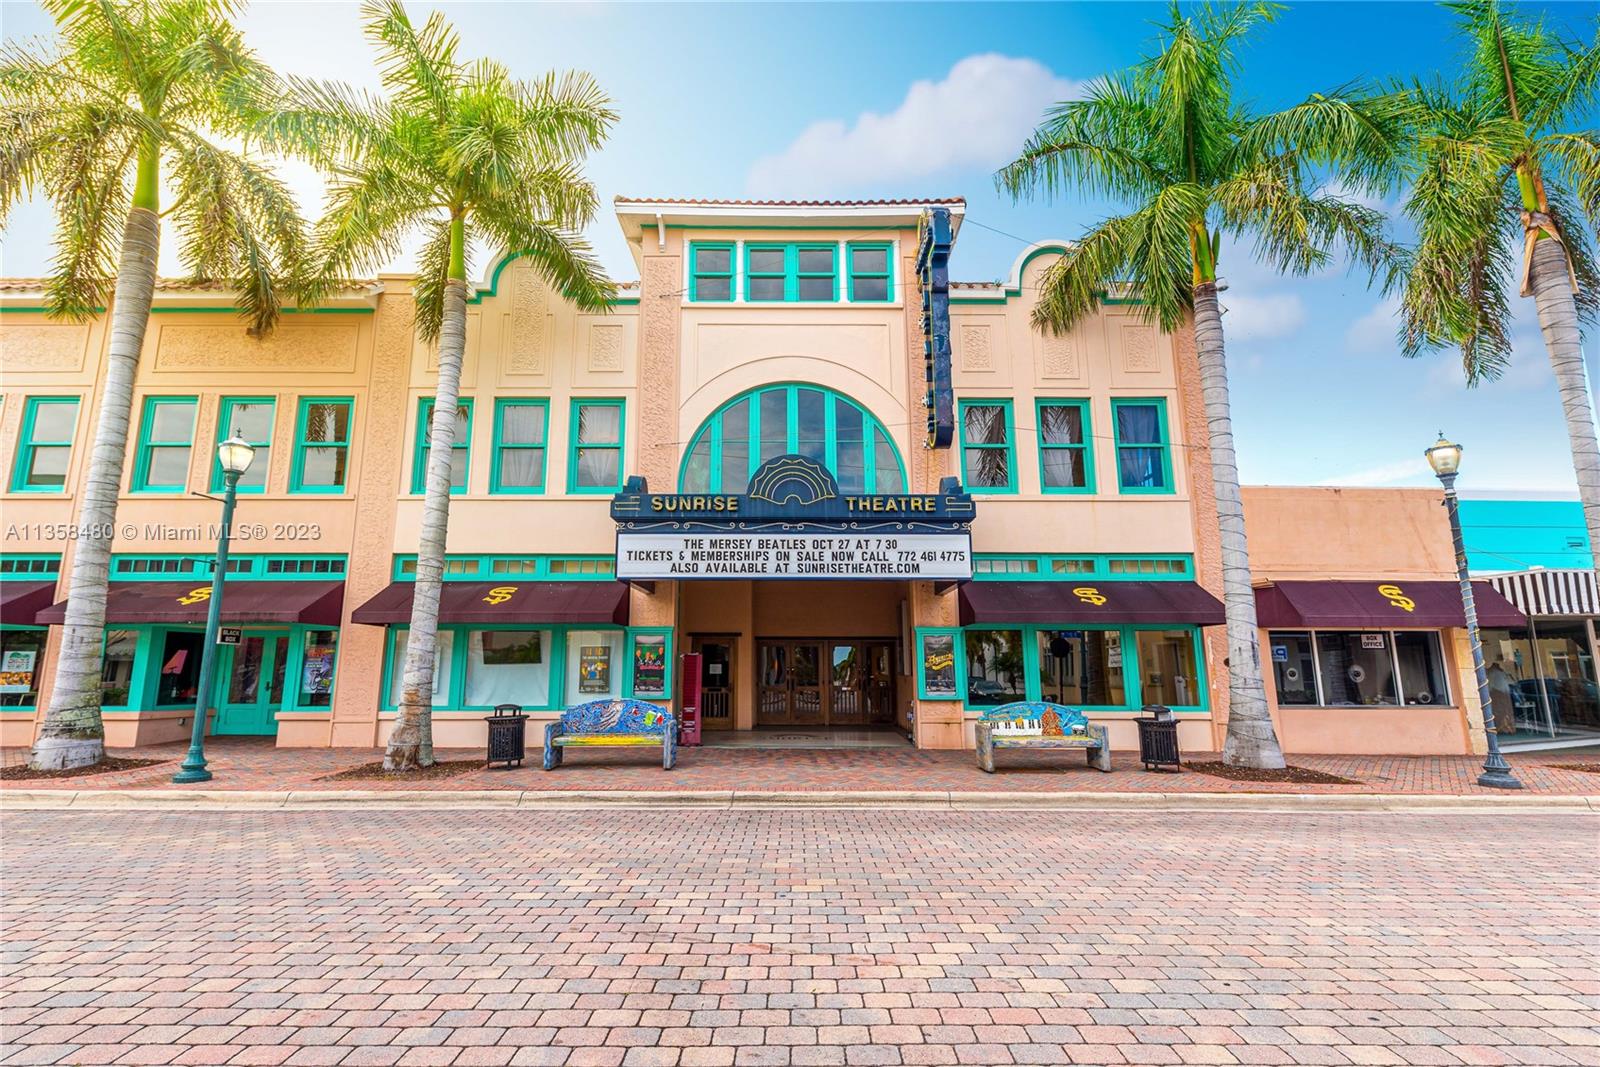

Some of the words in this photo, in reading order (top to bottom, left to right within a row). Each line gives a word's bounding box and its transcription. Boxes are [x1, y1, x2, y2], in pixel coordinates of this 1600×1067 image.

[651, 496, 739, 511] SUNRISE
[845, 497, 937, 512] THEATRE
[683, 539, 704, 550] THE
[709, 539, 752, 550] MERSEY
[757, 539, 806, 550] BEATLES
[812, 539, 834, 550] OCT
[838, 539, 851, 550] 27
[855, 539, 871, 550] AT
[875, 539, 882, 550] 7
[885, 539, 898, 550] 30
[626, 551, 673, 562] TICKETS
[678, 551, 685, 562] &
[691, 551, 770, 562] MEMBERSHIPS
[775, 551, 790, 562] ON
[796, 551, 825, 562] SALE
[831, 551, 855, 562] NOW
[861, 551, 890, 562] CALL
[897, 551, 917, 562] 772
[920, 551, 937, 562] 461
[940, 551, 965, 562] 4775
[669, 562, 699, 574] ALSO
[705, 562, 768, 574] AVAILABLE
[774, 562, 790, 574] AT
[797, 562, 920, 574] SUNRISETHEATRE.COM
